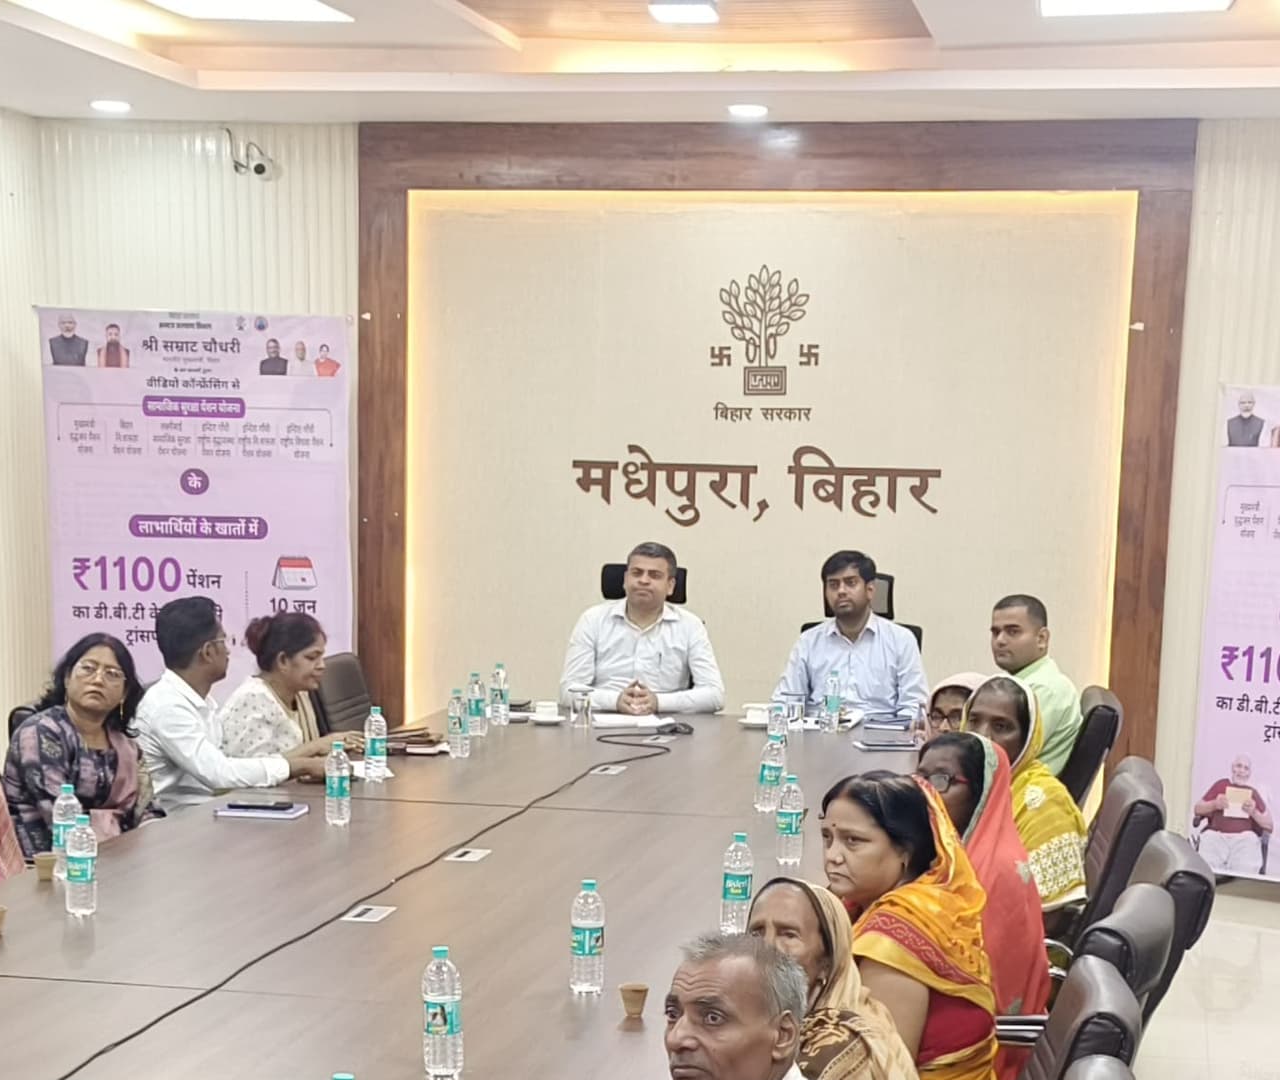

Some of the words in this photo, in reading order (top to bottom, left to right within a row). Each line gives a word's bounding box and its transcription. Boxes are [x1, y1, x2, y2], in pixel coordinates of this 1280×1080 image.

[142, 335, 158, 352] श्री
[161, 340, 198, 353] सम्राट
[202, 337, 241, 353] चौधरी
[713, 401, 752, 422] बिहार
[760, 406, 812, 422] सरकार
[187, 474, 202, 489] के
[572, 444, 770, 527] मधेपुरा,
[787, 445, 942, 517] बिहार
[137, 516, 198, 536] लाभार्थियों
[200, 519, 212, 535] के
[214, 519, 246, 537] खातों
[247, 521, 259, 536] में
[72, 555, 182, 593] ₹1100
[186, 569, 222, 589] पेंशन
[72, 605, 90, 619] का
[93, 602, 145, 620] डी.बी.टी
[270, 597, 288, 613] 10
[1216, 695, 1233, 711] का
